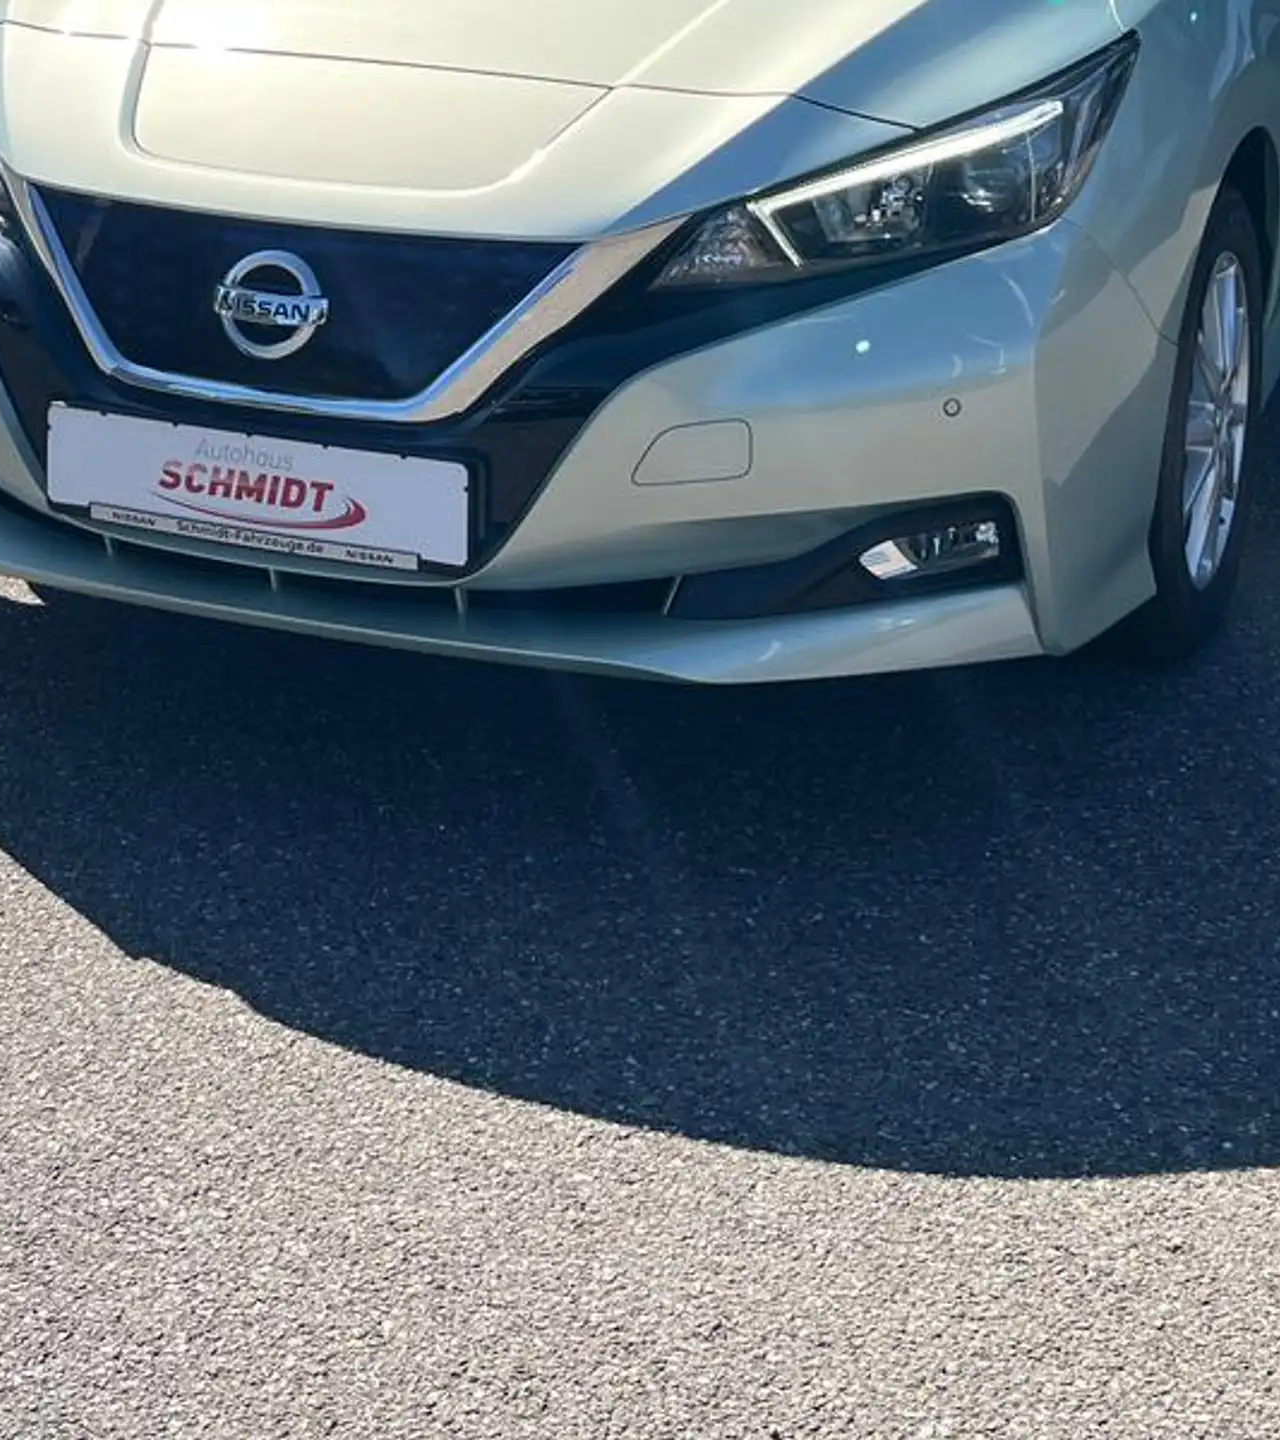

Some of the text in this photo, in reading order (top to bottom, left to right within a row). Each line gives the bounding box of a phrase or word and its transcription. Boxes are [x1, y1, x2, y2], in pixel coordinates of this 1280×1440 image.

[219, 290, 310, 321] NISSAN
[195, 437, 294, 472] Autohaus
[158, 459, 334, 512] SCHMIDT
